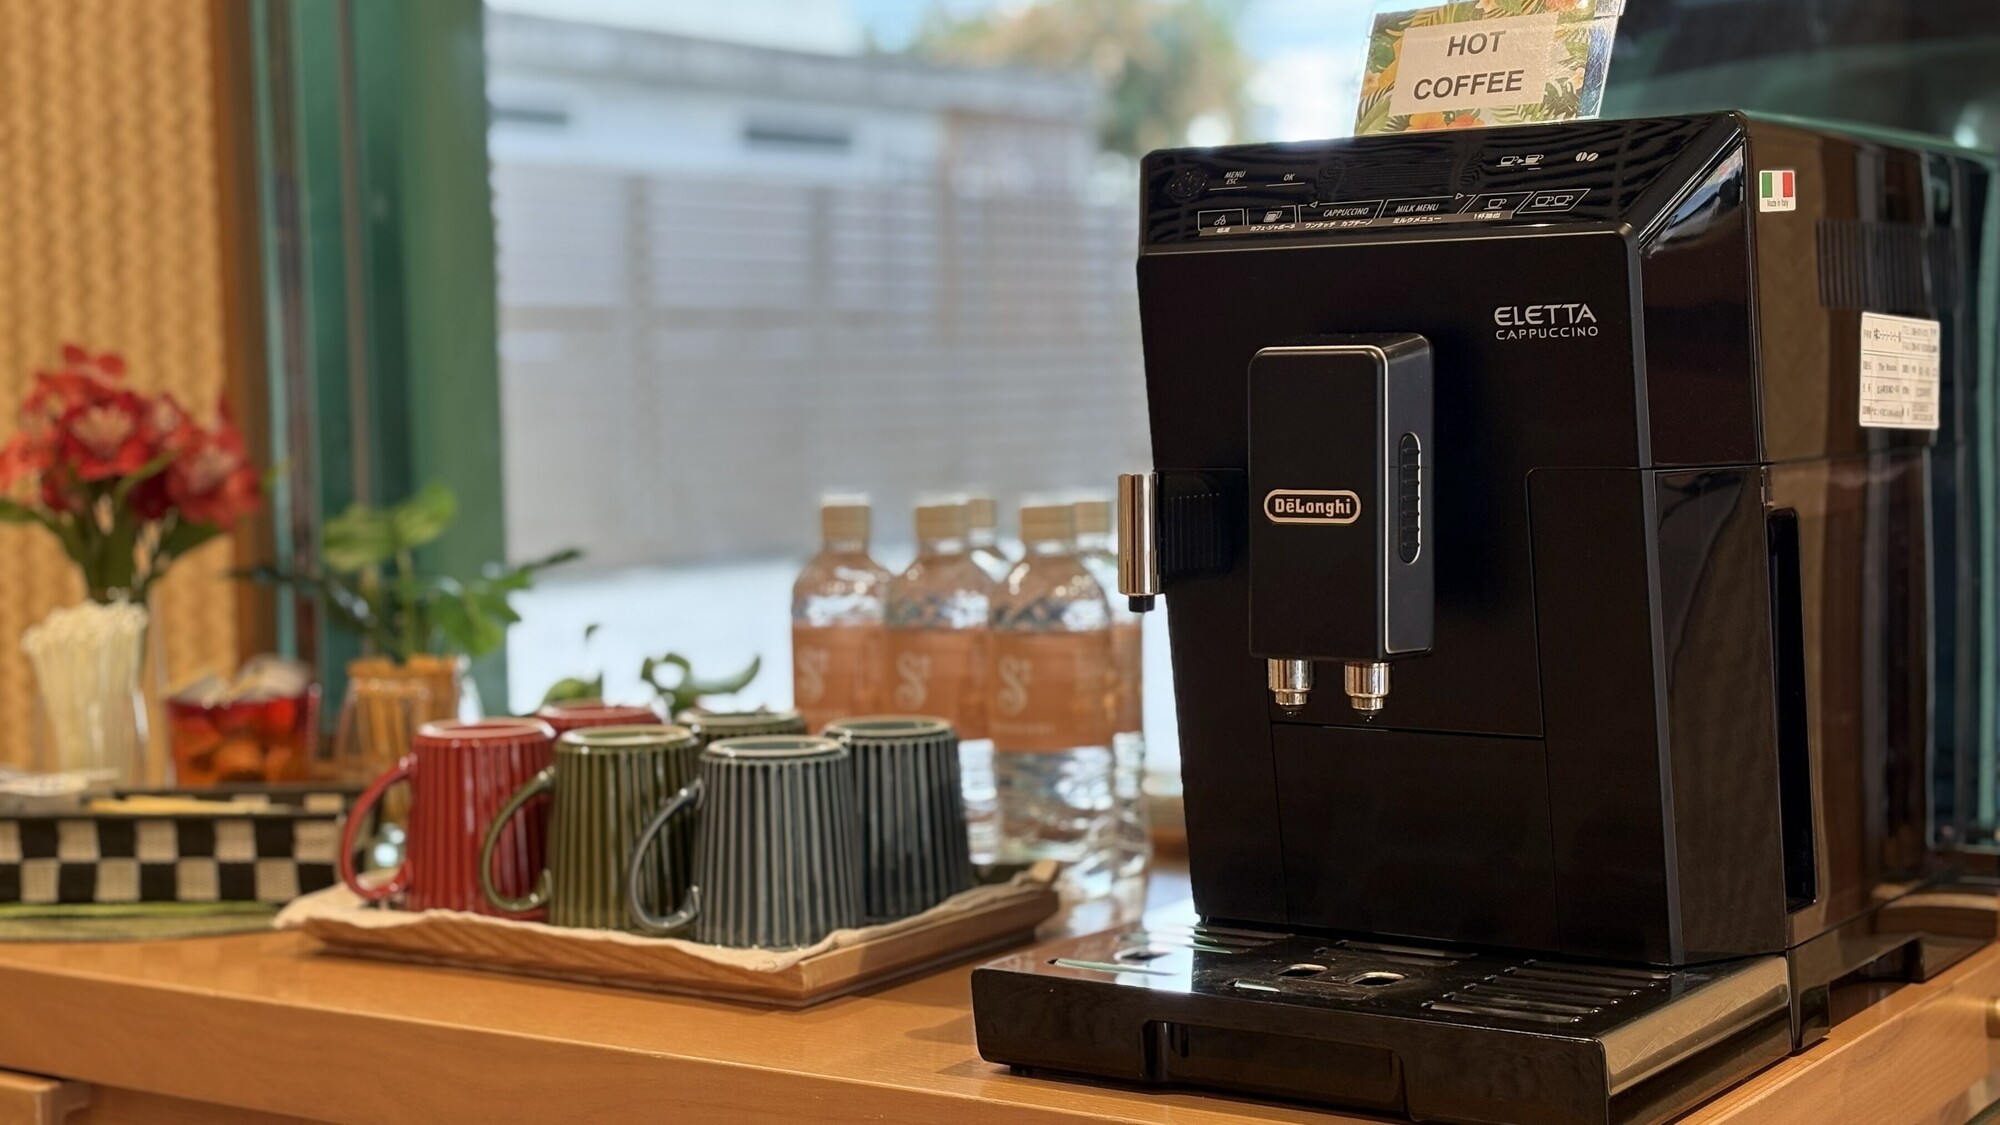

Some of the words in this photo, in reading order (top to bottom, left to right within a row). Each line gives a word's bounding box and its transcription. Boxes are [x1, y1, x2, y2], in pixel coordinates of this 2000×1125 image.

[1447, 30, 1506, 57] HOT
[1413, 69, 1525, 101] COFFEE
[1224, 170, 1246, 179] MENU
[1283, 173, 1295, 181] OK
[1323, 207, 1370, 218] CAPPUCCINO
[1415, 203, 1440, 213] MENU
[1494, 303, 1597, 326] ELETTA
[1495, 326, 1599, 340] CAPPUCCINO
